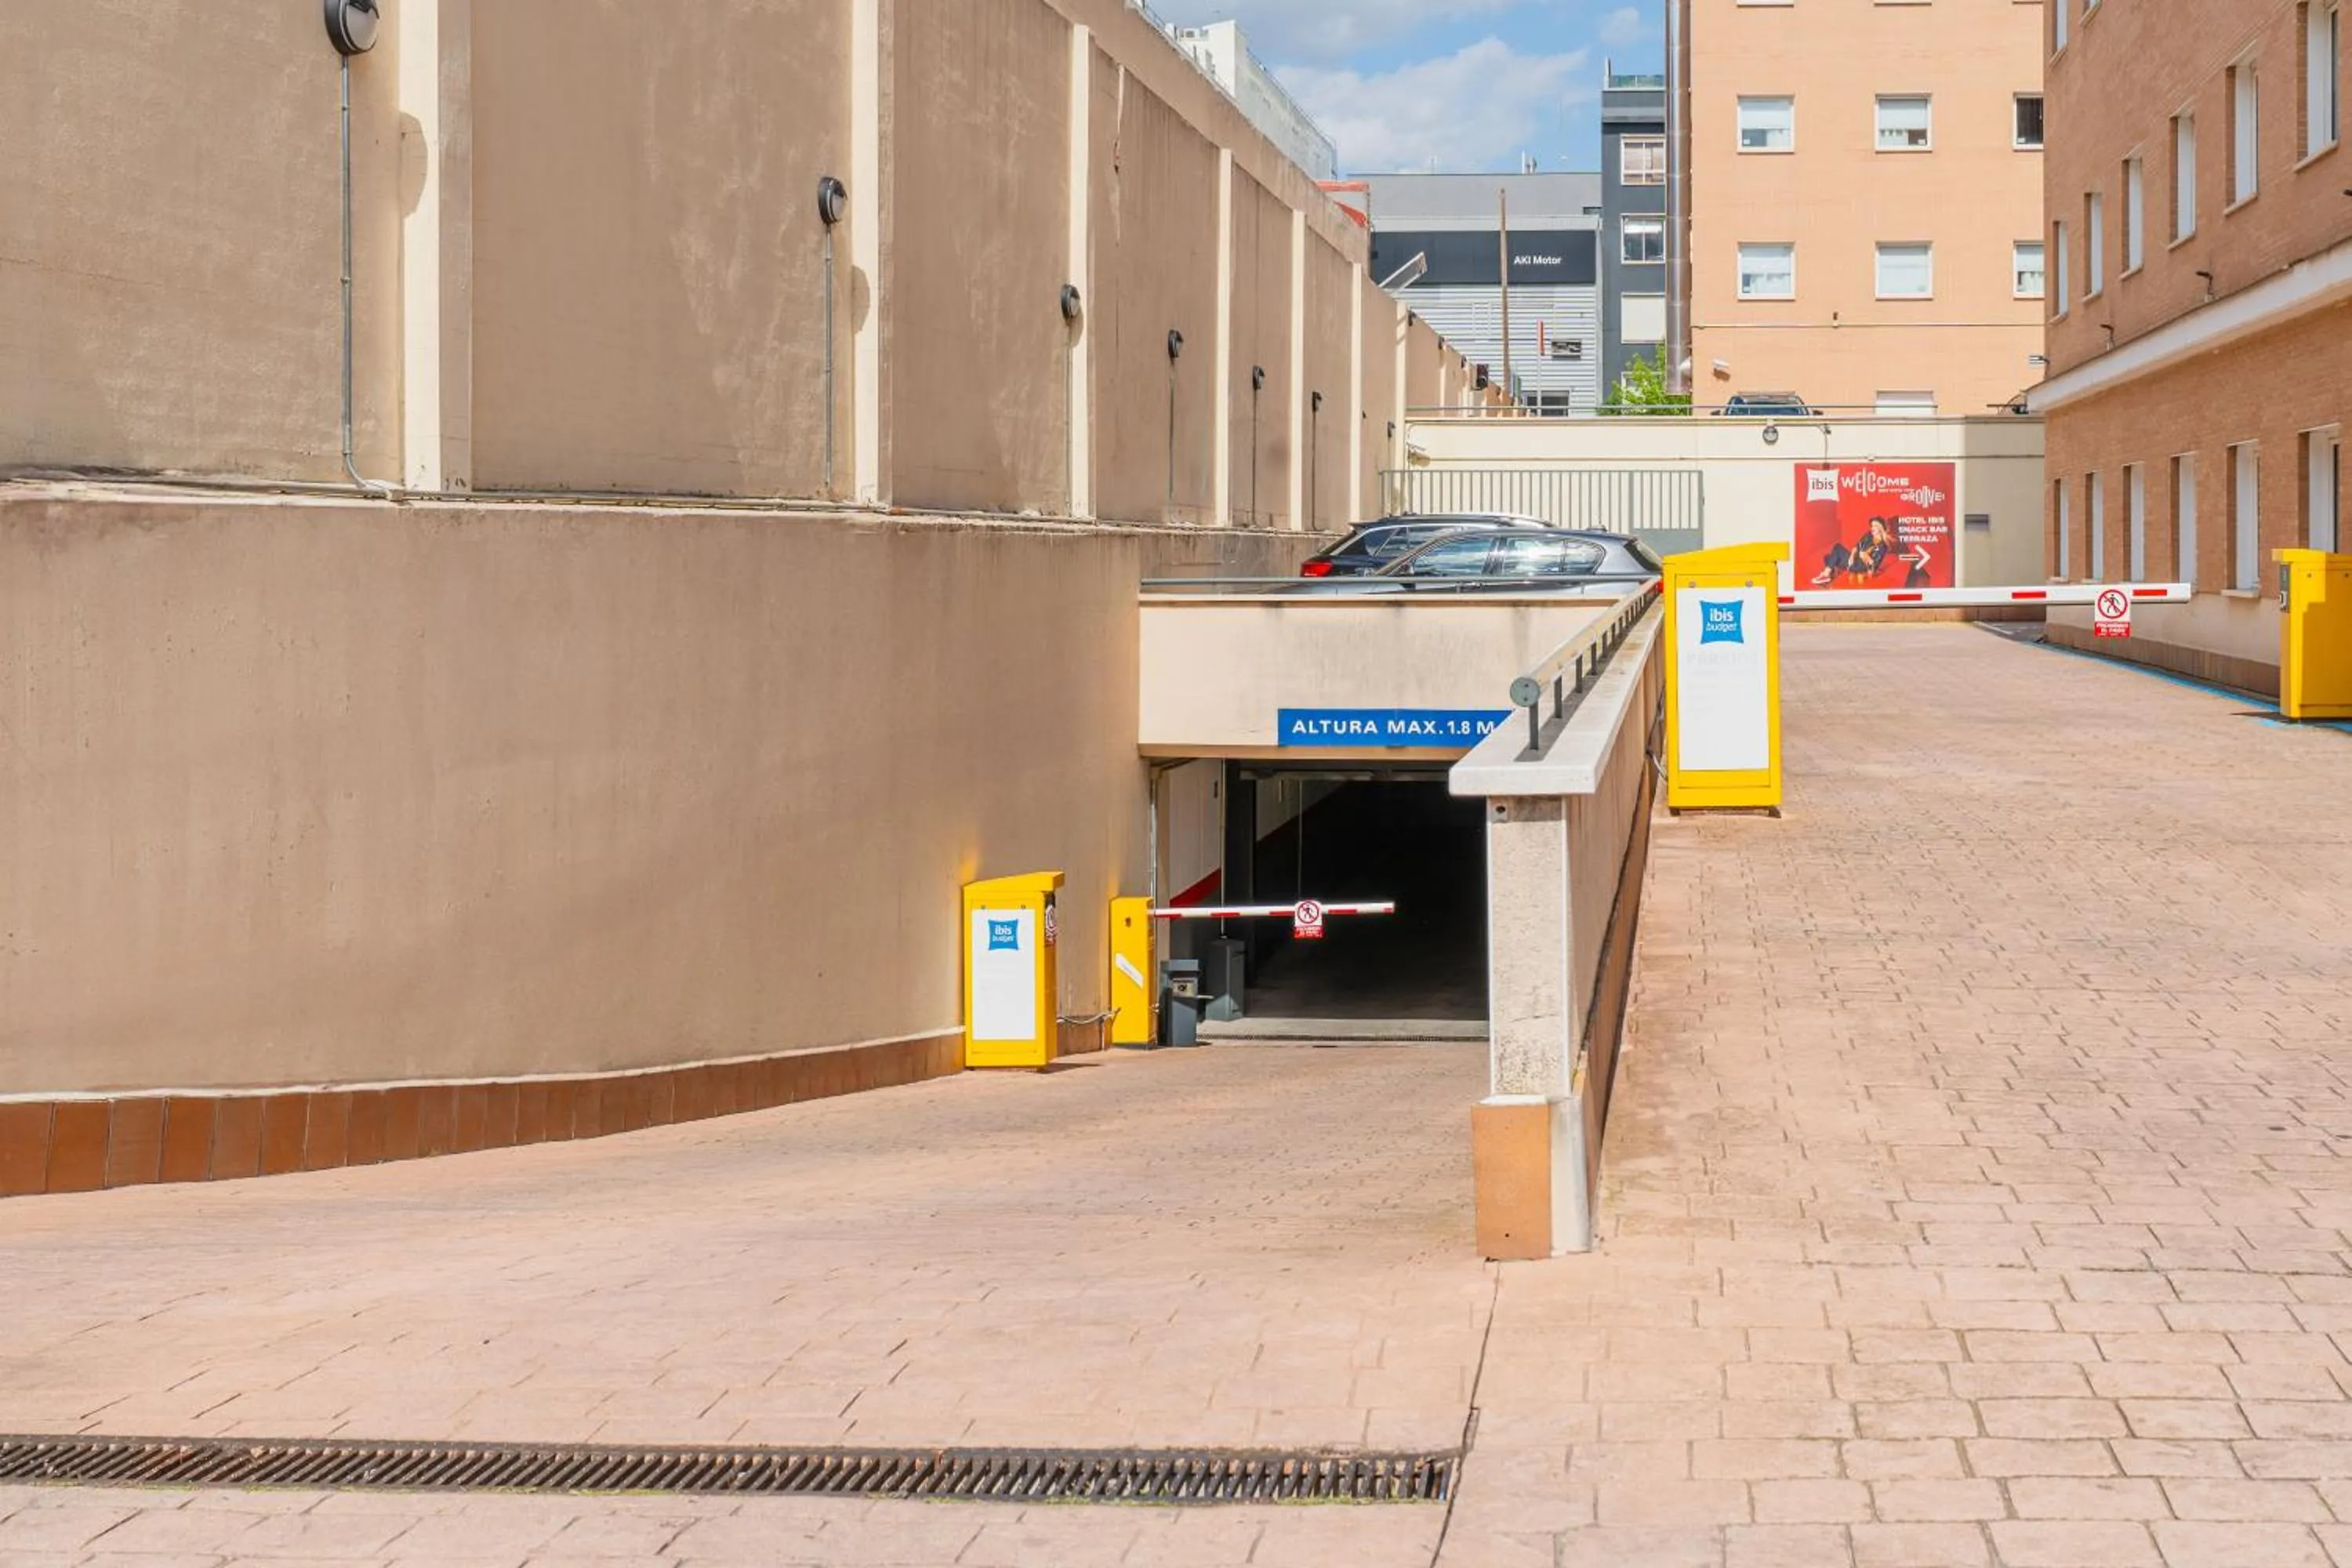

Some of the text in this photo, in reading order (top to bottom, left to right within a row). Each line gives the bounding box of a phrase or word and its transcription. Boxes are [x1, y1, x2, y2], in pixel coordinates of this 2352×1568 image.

[1513, 255, 1562, 264] AKI Motor
[1812, 477, 1835, 490] ibis
[1710, 608, 1733, 622] ibis
[1705, 622, 1737, 633] budget
[1291, 720, 1378, 735] ALTURA
[1387, 720, 1444, 735] MAX.
